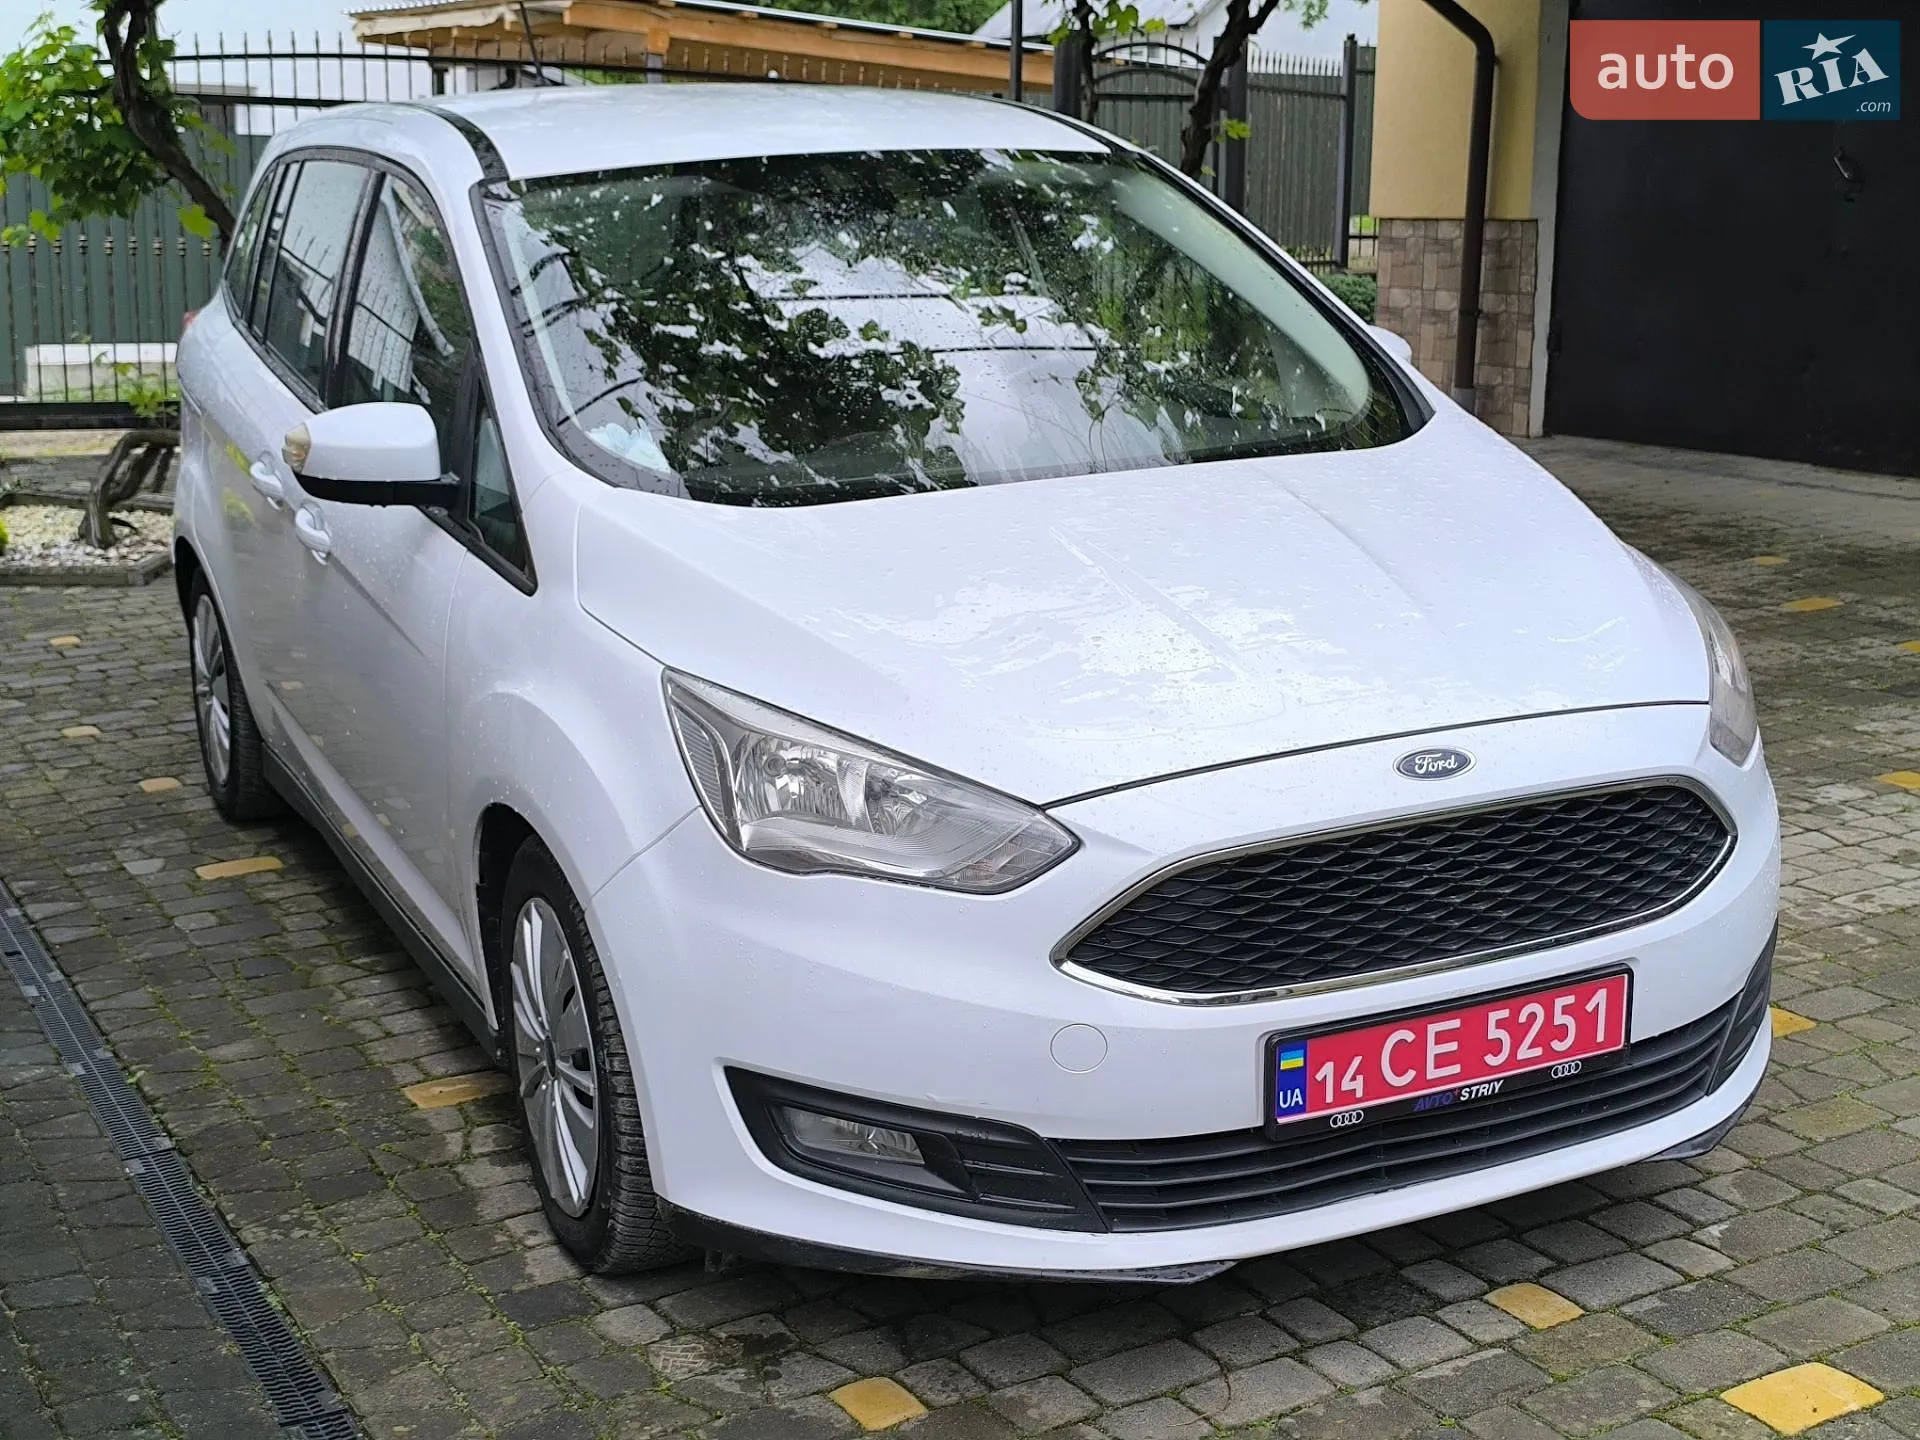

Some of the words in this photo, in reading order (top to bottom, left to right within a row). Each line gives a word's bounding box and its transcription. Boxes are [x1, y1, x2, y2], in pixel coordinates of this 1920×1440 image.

[1415, 752, 1458, 774] Ford
[1314, 1055, 1364, 1104] 14
[1380, 1018, 1461, 1088] CE
[1483, 988, 1608, 1067] 5251
[1279, 1087, 1304, 1109] UA
[1460, 1079, 1505, 1101] STRIY
